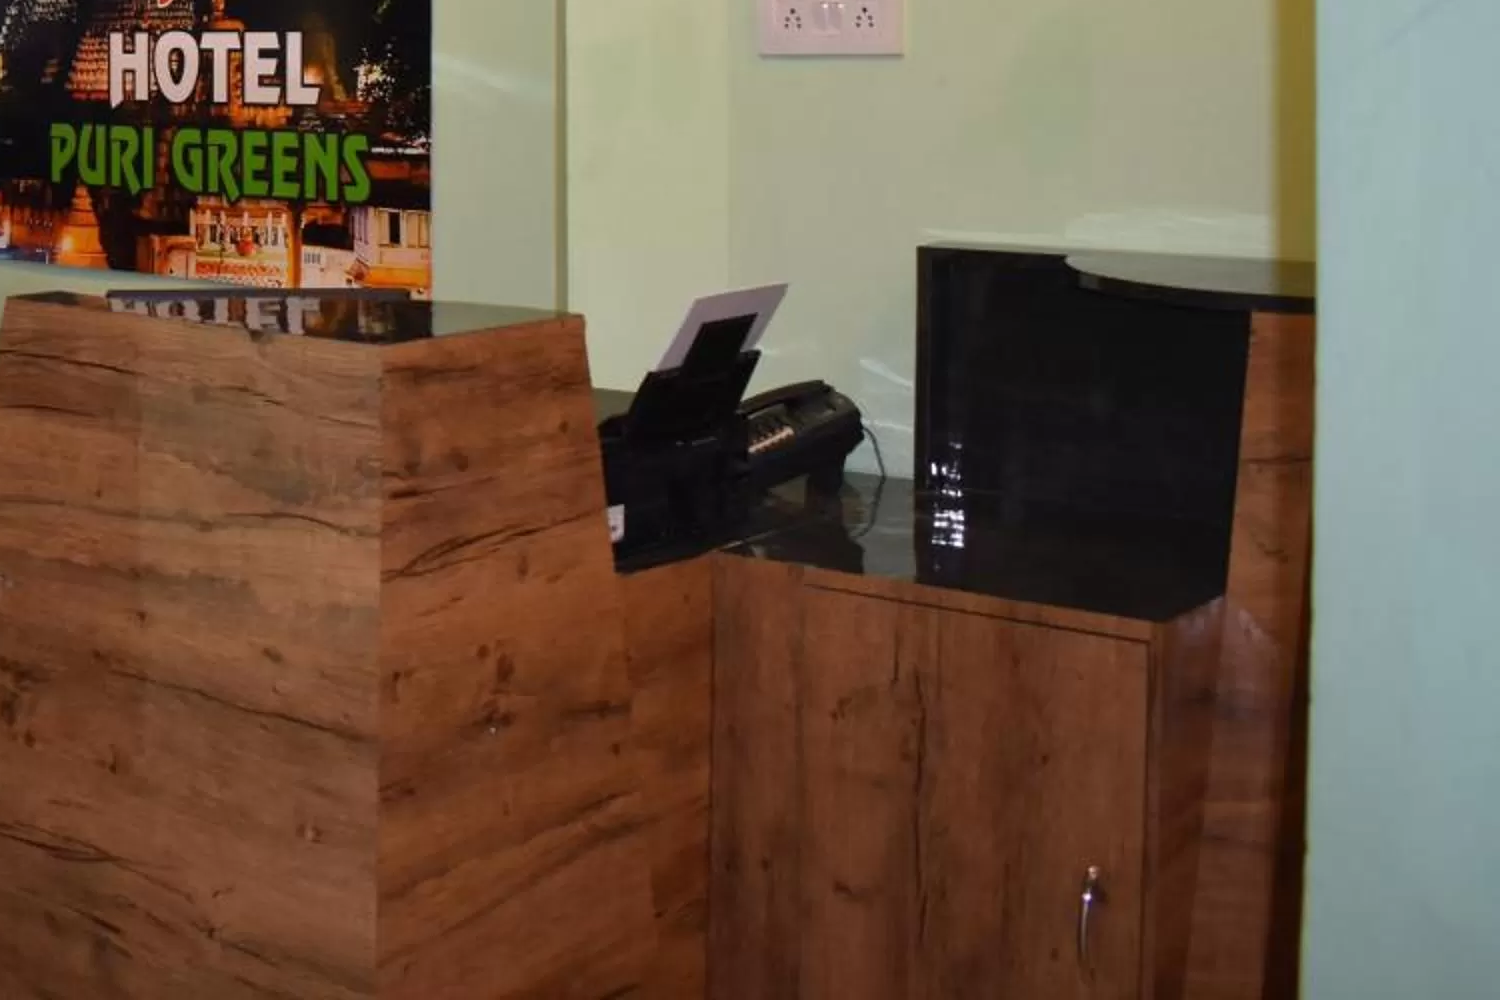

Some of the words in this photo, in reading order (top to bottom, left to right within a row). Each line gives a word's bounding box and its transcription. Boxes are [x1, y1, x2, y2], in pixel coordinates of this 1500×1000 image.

[109, 31, 321, 107] HOTEL
[50, 123, 155, 196] PURI
[172, 127, 372, 204] GREENS
